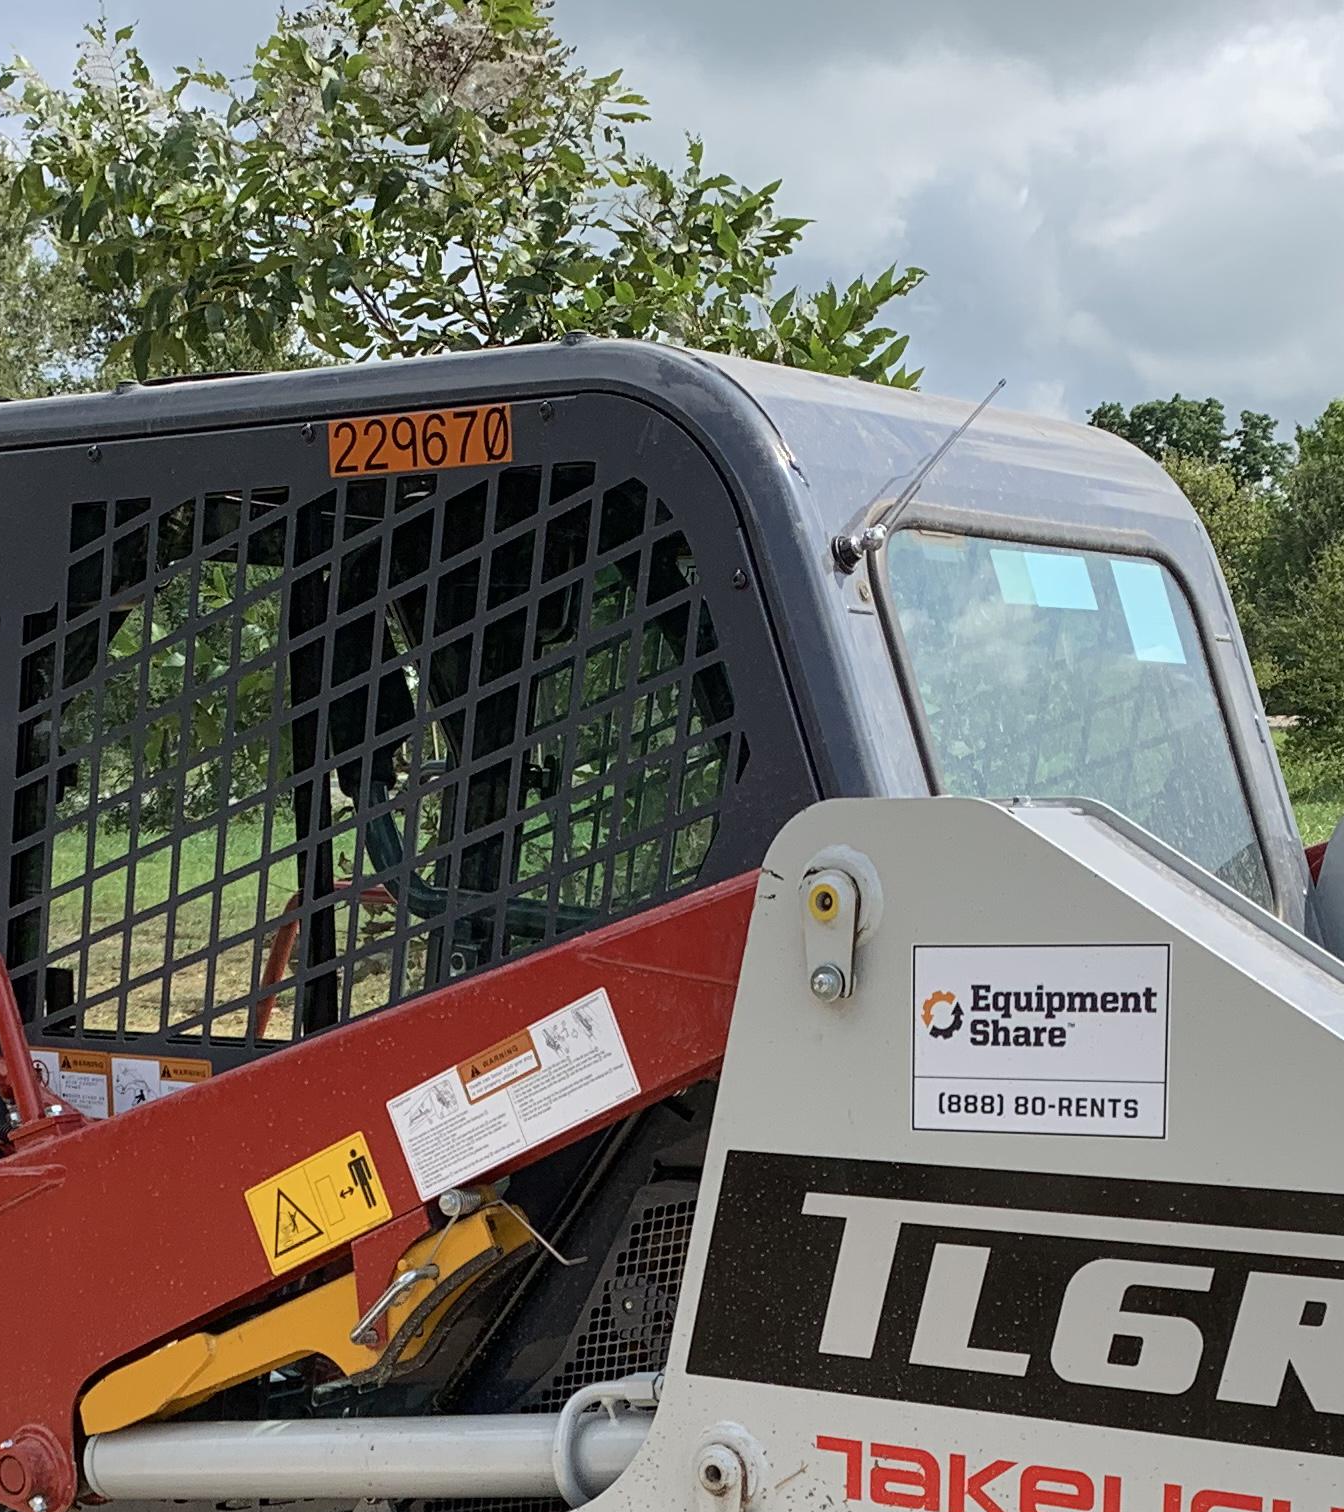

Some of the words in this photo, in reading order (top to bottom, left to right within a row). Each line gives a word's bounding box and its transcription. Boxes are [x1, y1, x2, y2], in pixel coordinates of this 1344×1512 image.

[333, 404, 507, 474] 229670
[970, 984, 1158, 1019] Equipment
[482, 1044, 519, 1068] WARNING
[938, 1092, 1004, 1116] (888)
[1014, 1095, 1139, 1119] 80-RENTS
